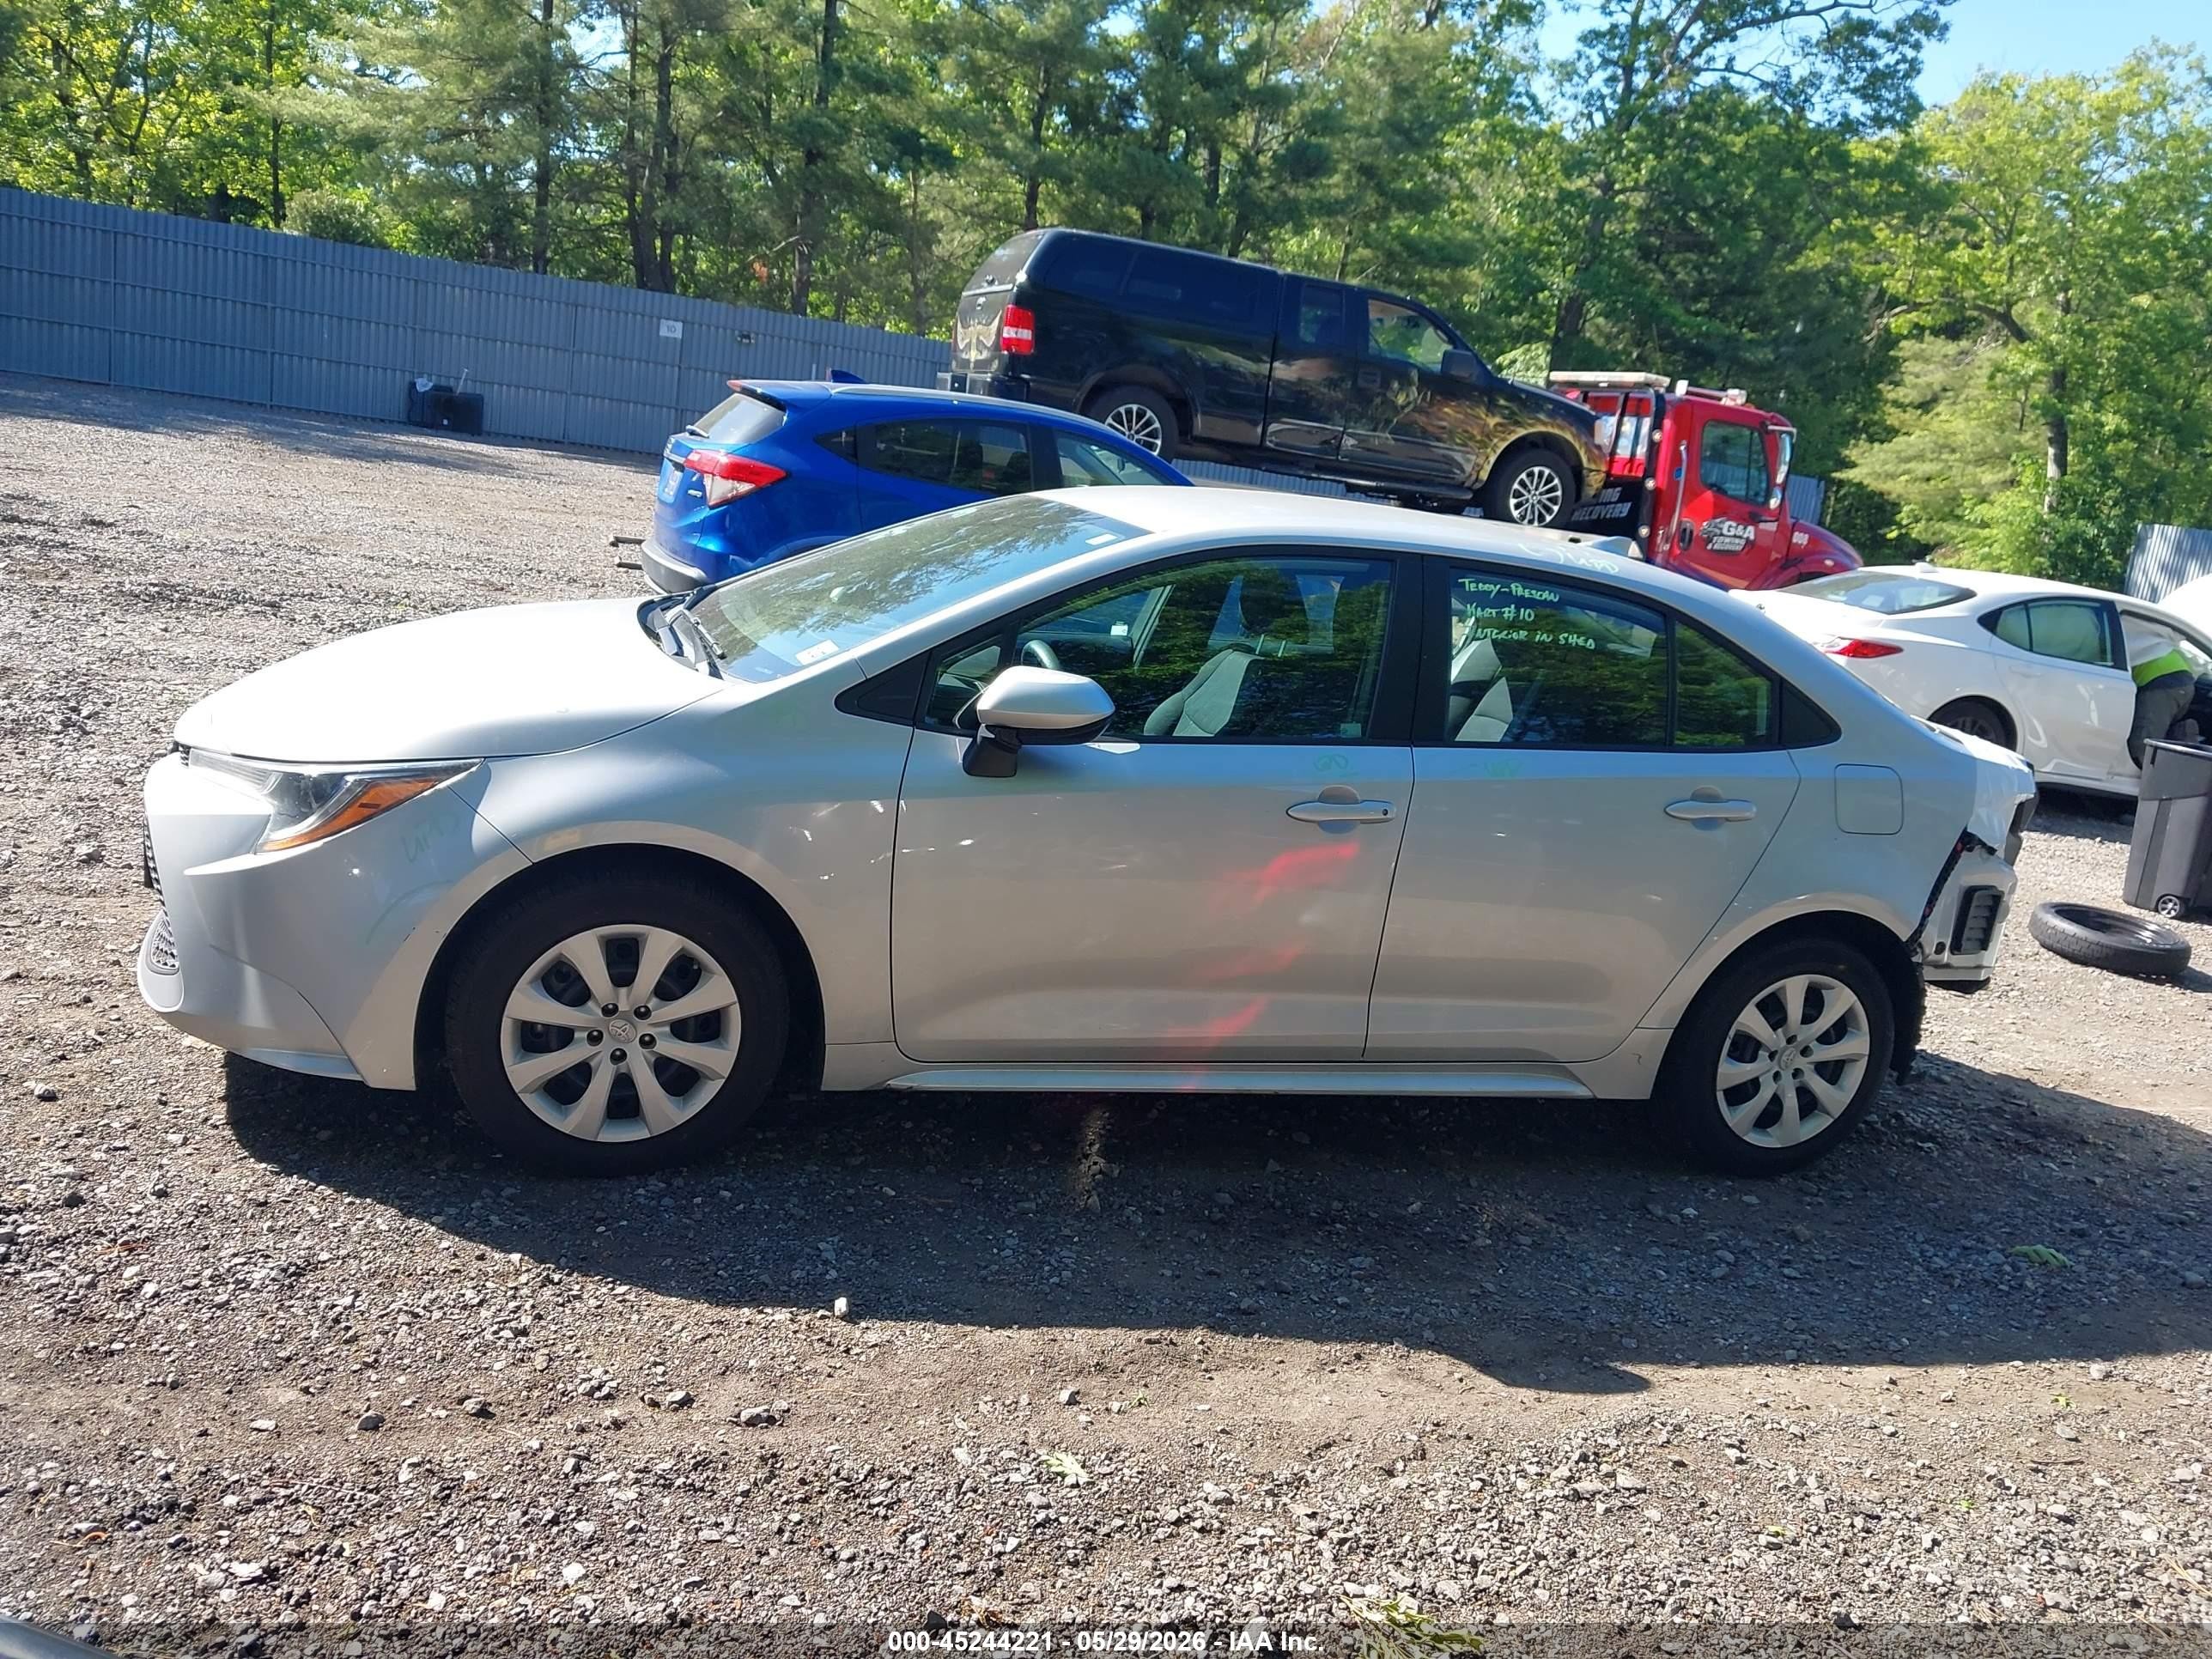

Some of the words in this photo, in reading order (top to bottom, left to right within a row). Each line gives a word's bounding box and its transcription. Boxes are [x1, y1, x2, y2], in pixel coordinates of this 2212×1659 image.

[1571, 501, 1632, 521] RECOVERY
[1722, 520, 1755, 541] G&A
[1559, 633, 1595, 650] SHED
